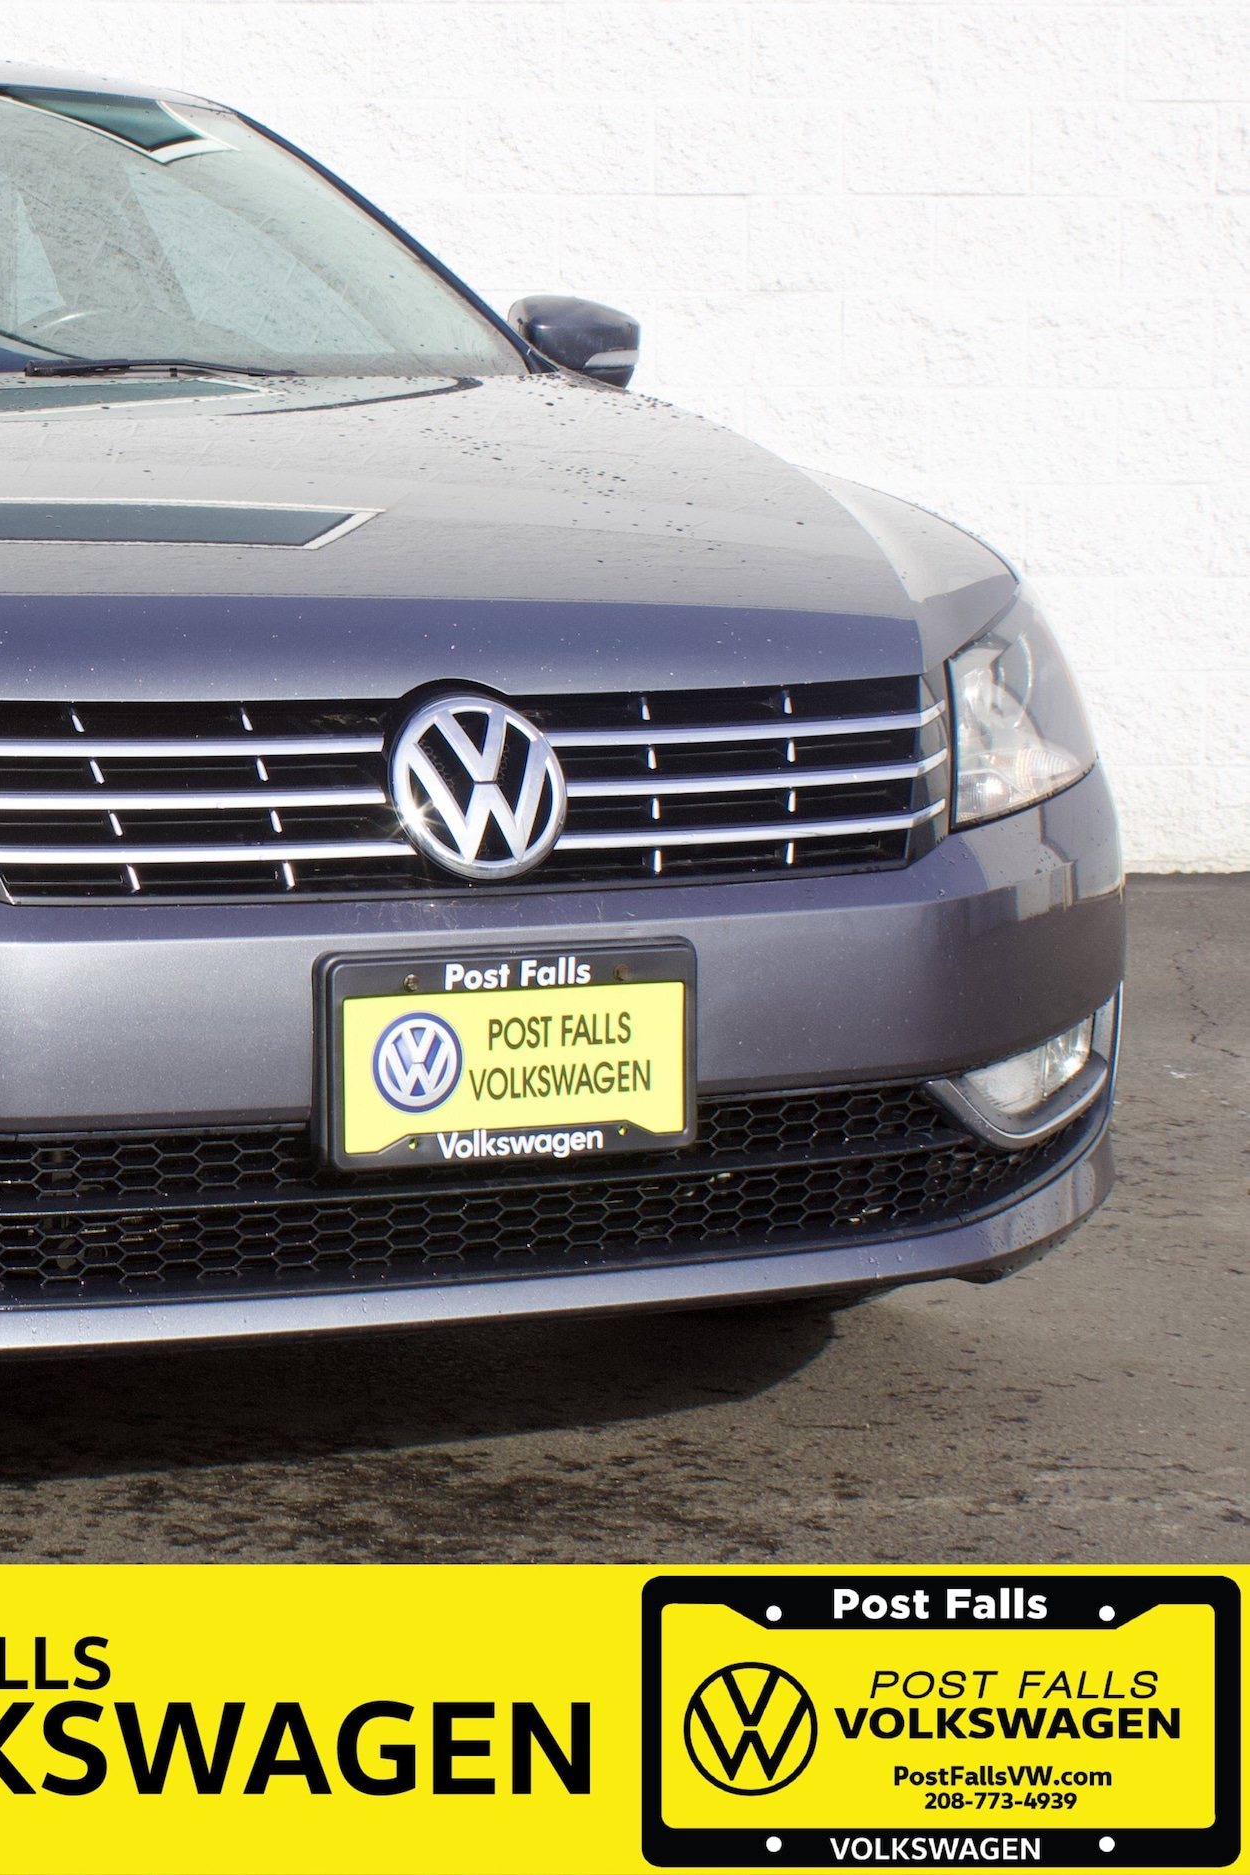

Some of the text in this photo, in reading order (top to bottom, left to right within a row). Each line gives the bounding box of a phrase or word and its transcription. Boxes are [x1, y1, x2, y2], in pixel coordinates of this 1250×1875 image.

[444, 956, 591, 991] Post Falls
[488, 1012, 632, 1051] POST FALLS
[468, 1060, 651, 1101] VOLKSWAGEN
[436, 1128, 604, 1159] Volkswagen
